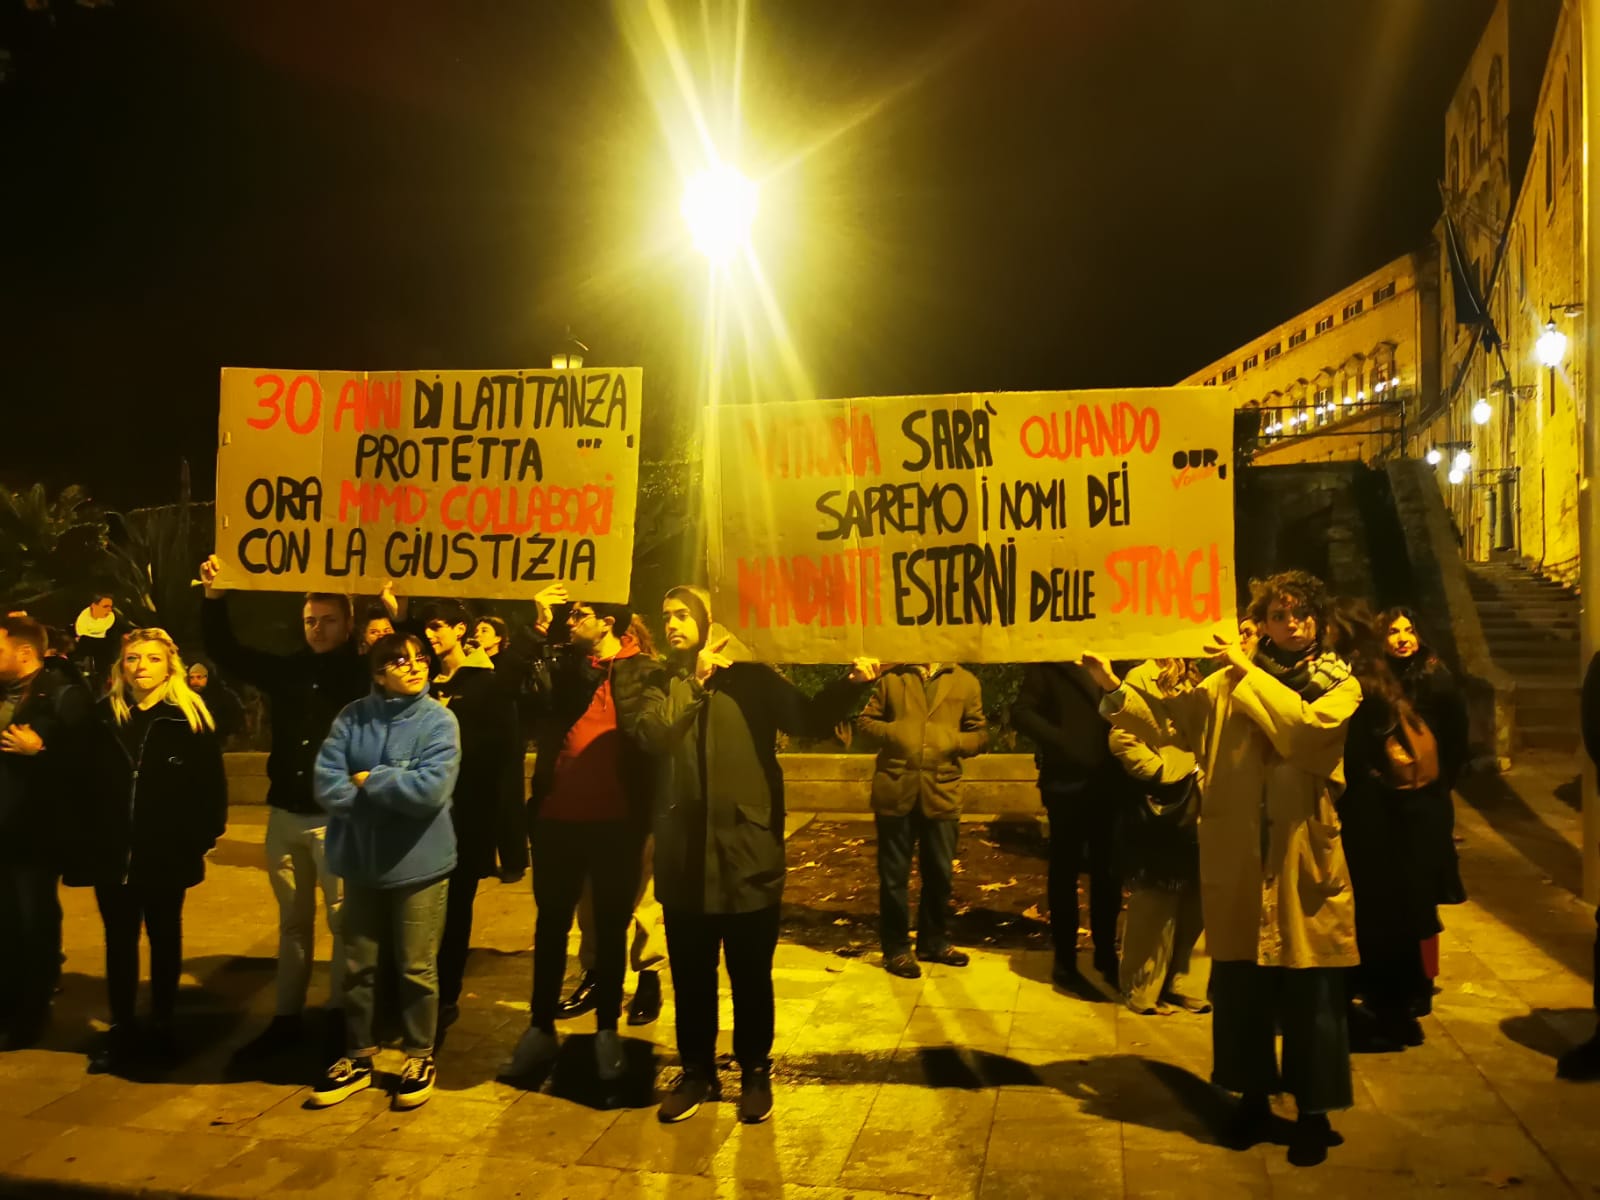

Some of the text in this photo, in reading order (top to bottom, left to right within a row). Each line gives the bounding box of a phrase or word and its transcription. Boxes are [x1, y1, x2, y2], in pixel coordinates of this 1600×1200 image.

[247, 374, 322, 434] 30
[1020, 401, 1160, 460] QUANDO
[355, 434, 543, 482] PROTETTA
[245, 475, 323, 522] ORA
[815, 482, 968, 541] SAPREMO
[1000, 479, 1067, 531] NOMI
[237, 527, 310, 575] CON
[325, 527, 367, 577] LA
[1029, 568, 1096, 623] DELLE
[1104, 543, 1221, 623] STRAGI
